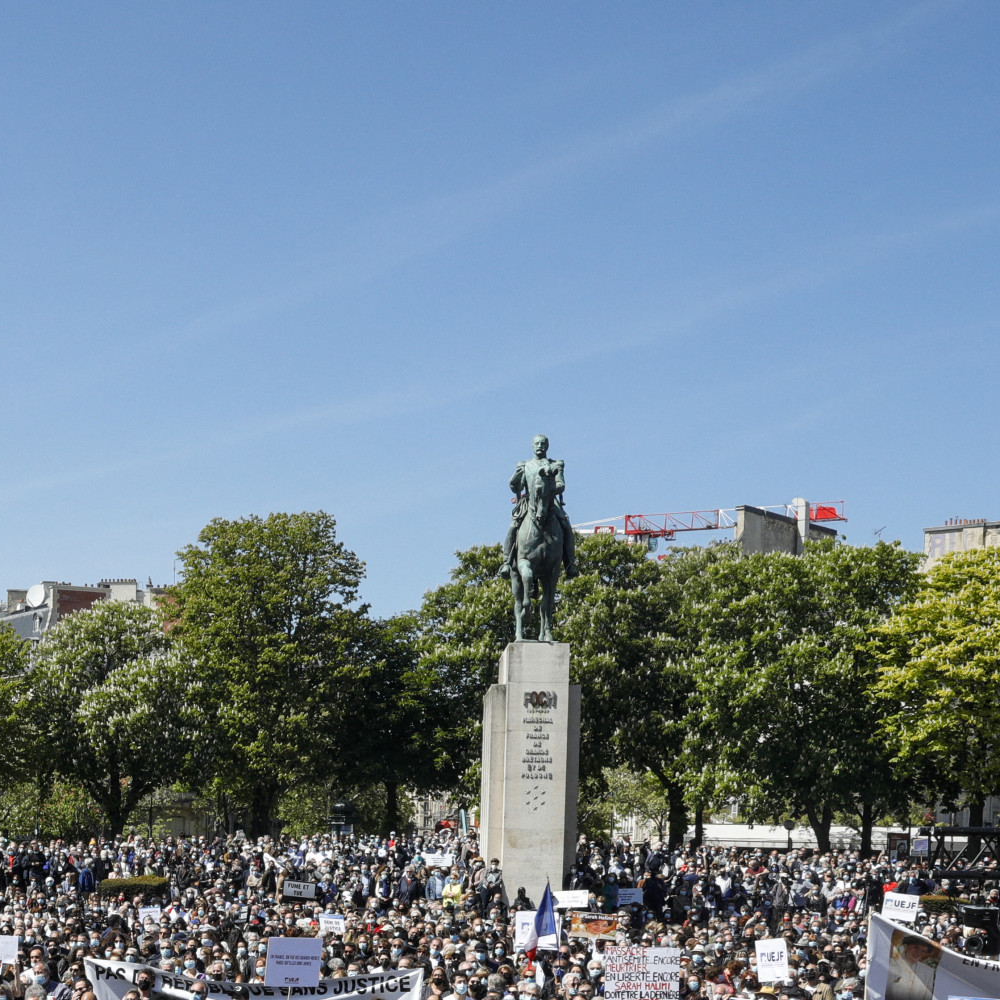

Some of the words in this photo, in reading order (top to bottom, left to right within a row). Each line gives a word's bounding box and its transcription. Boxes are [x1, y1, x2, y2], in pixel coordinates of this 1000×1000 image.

[523, 690, 558, 709] FOCH
[894, 899, 917, 910] UEJF
[605, 946, 648, 956] MASSACRE
[767, 951, 784, 962] UEJF
[605, 963, 648, 972] MEURTRIER
[95, 965, 126, 981] PAS
[333, 975, 411, 996] JUSTICE
[605, 973, 616, 981] EN
[653, 971, 680, 982] ENCORE
[614, 982, 642, 991] SARAH
[645, 982, 671, 990] HALIMI
[640, 991, 649, 999] LA
